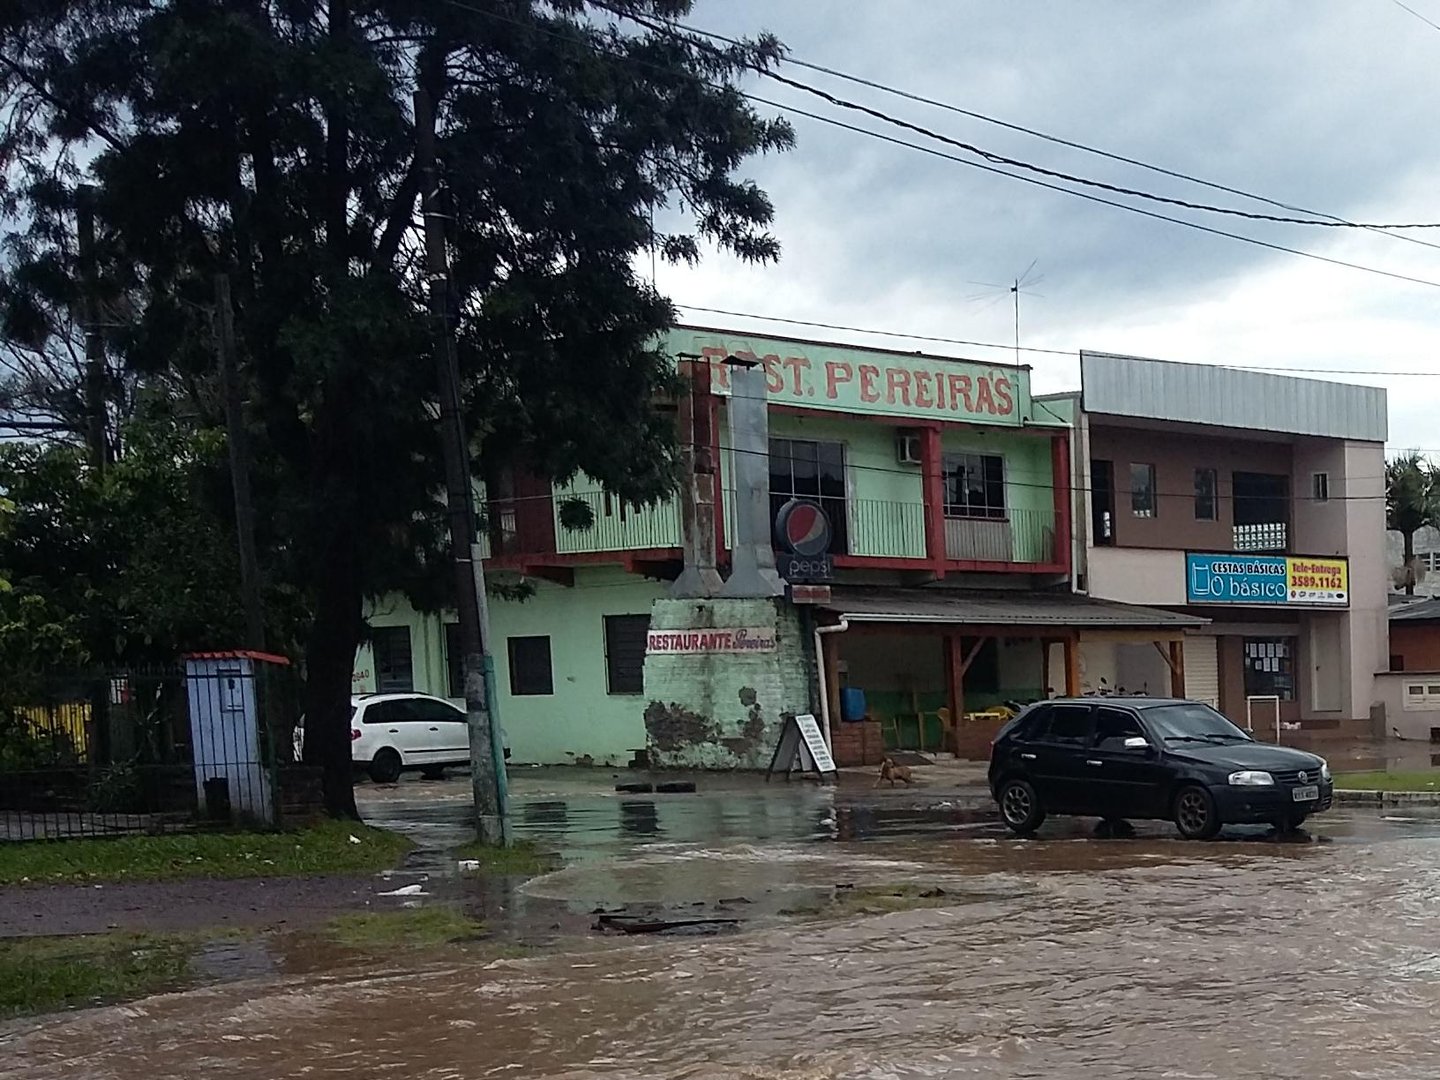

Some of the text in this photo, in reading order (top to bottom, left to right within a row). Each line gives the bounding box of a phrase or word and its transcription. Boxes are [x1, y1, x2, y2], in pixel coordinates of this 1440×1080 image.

[789, 560, 831, 577] pepsi
[1212, 560, 1286, 576] CESTAS BÁSICAS
[1292, 562, 1342, 577] Tele-Entrega
[1229, 577, 1287, 598] básico
[1291, 575, 1342, 590] 3589.1162
[650, 633, 731, 651] RESTAURANTE
